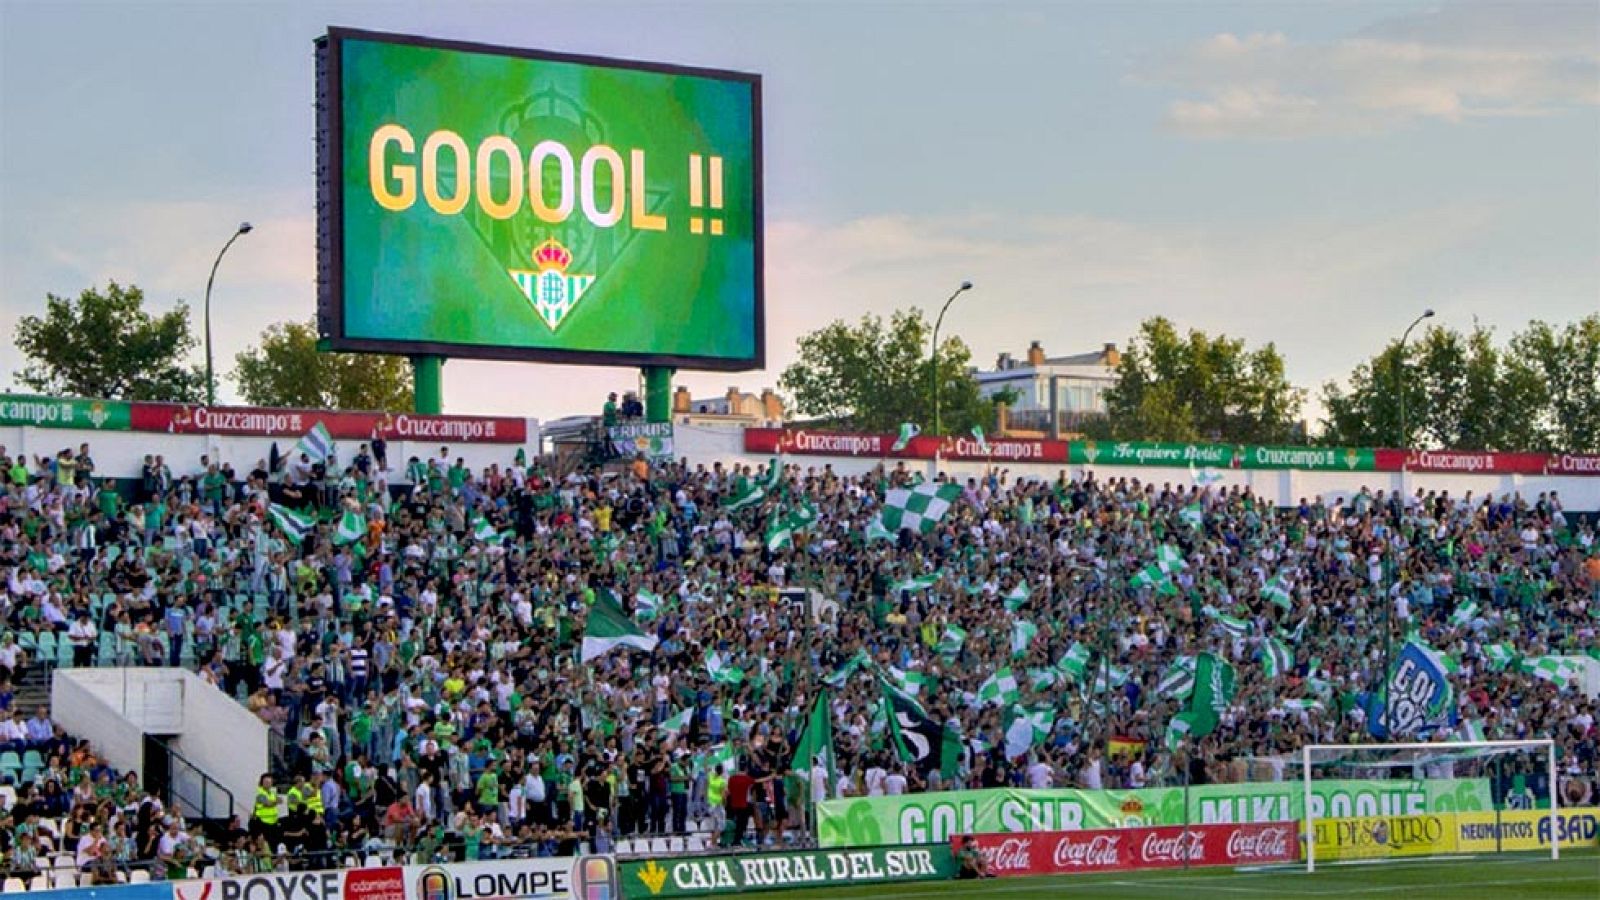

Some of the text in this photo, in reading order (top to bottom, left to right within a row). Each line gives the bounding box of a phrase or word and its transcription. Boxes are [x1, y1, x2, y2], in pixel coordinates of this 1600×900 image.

[368, 123, 668, 231] GOOOOL
[194, 407, 287, 434] Cruzcampo
[396, 415, 483, 440] Cruzcampo
[795, 430, 870, 455] Cruzcampo
[1256, 447, 1325, 469] Cruzcampo
[1419, 451, 1483, 471] Cruzcampo
[672, 850, 937, 889] CAJA RURAL DEL SUR
